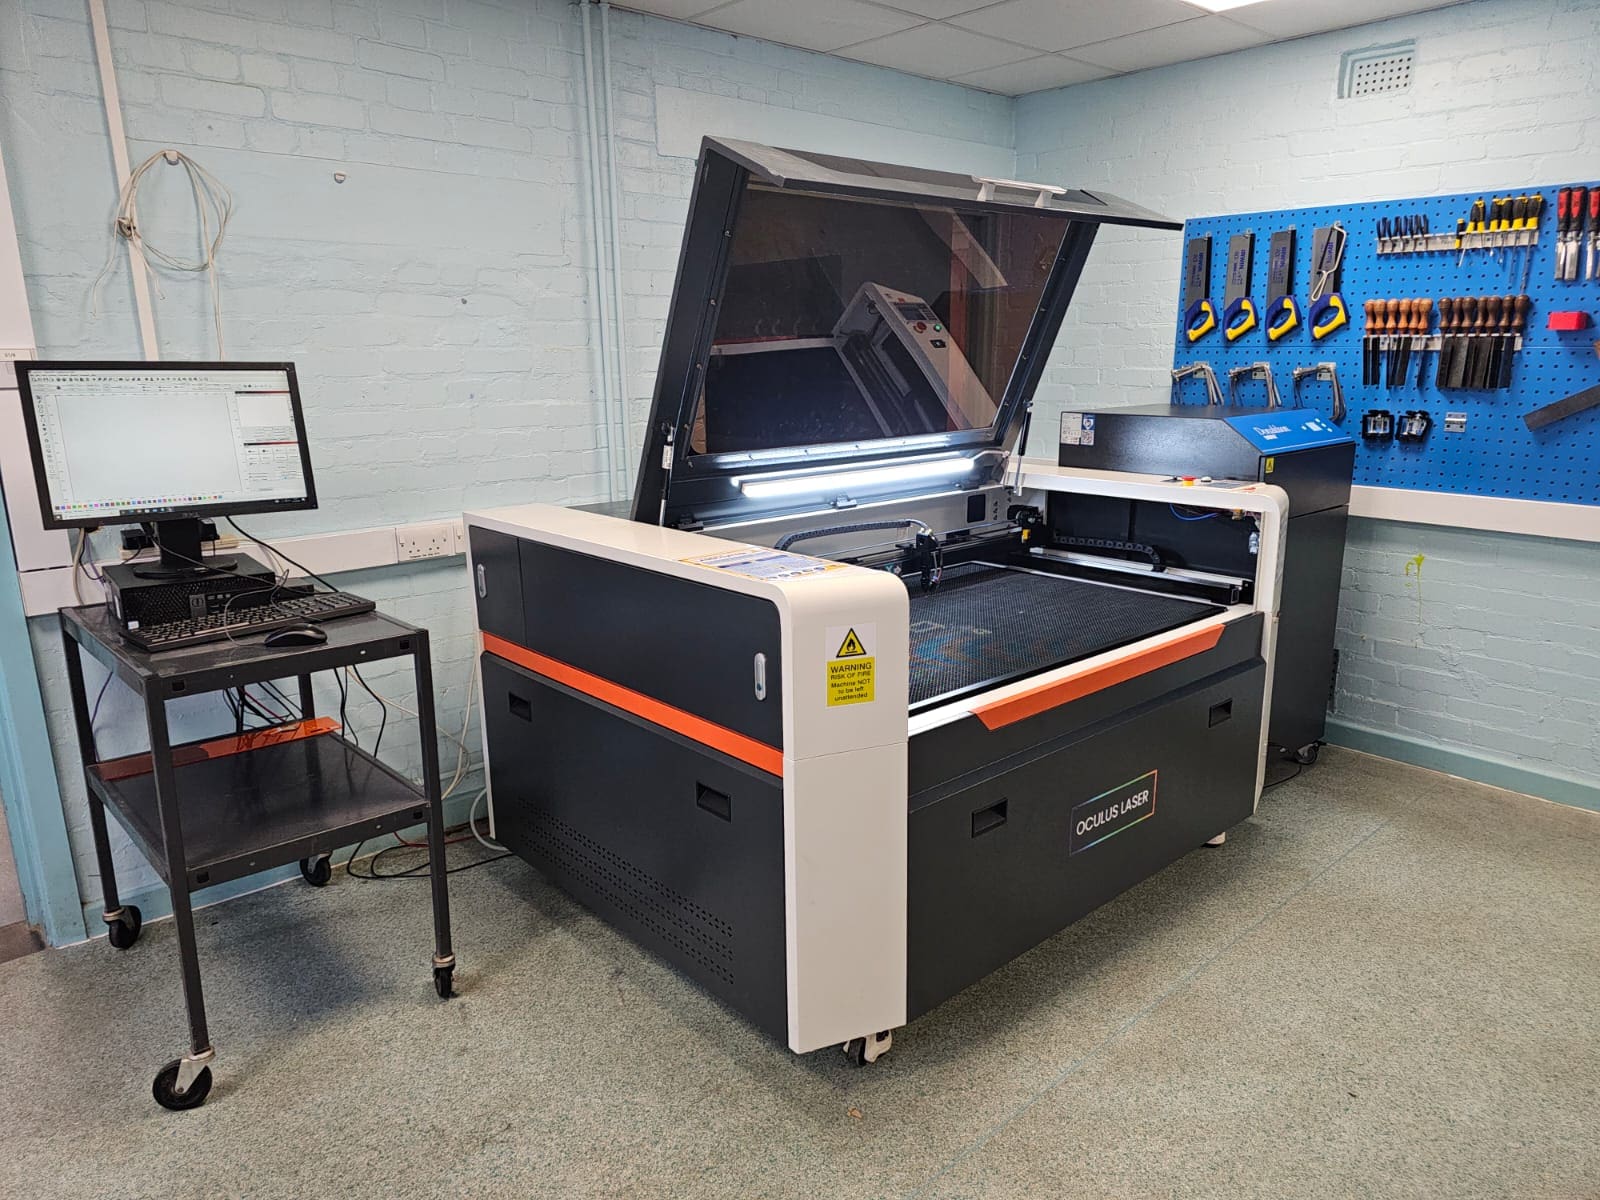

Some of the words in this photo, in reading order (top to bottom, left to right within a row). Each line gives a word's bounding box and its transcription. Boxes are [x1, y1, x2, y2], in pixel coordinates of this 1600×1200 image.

[831, 662, 872, 673] WARNING
[834, 692, 868, 701] unattended
[1076, 804, 1119, 836] OCULUS
[1120, 790, 1149, 814] LASER
